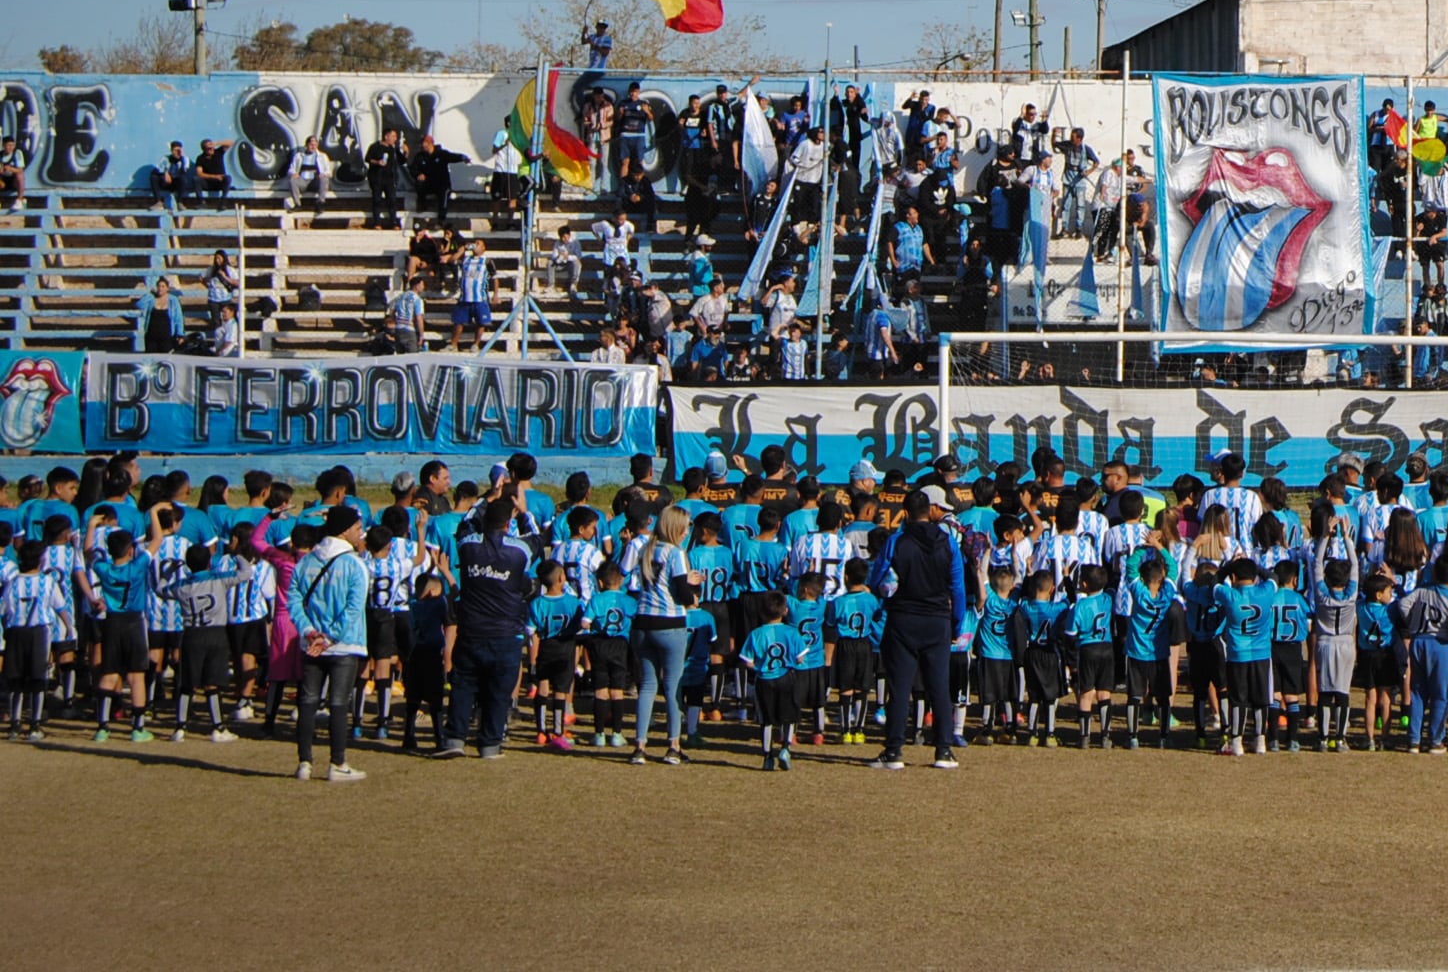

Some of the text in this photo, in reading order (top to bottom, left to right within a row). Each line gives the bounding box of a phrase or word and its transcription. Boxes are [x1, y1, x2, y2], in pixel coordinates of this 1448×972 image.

[235, 83, 441, 185] SAN
[192, 364, 632, 448] FERROVIARIO
[692, 393, 824, 475] La
[855, 386, 1163, 480] Banda
[1196, 389, 1293, 476] de
[112, 580, 131, 609] 7
[20, 595, 38, 627] 7
[605, 607, 625, 636] 8
[849, 612, 866, 638] 9
[1239, 604, 1262, 636] 2
[1273, 604, 1299, 642] 15
[767, 642, 787, 671] 8
